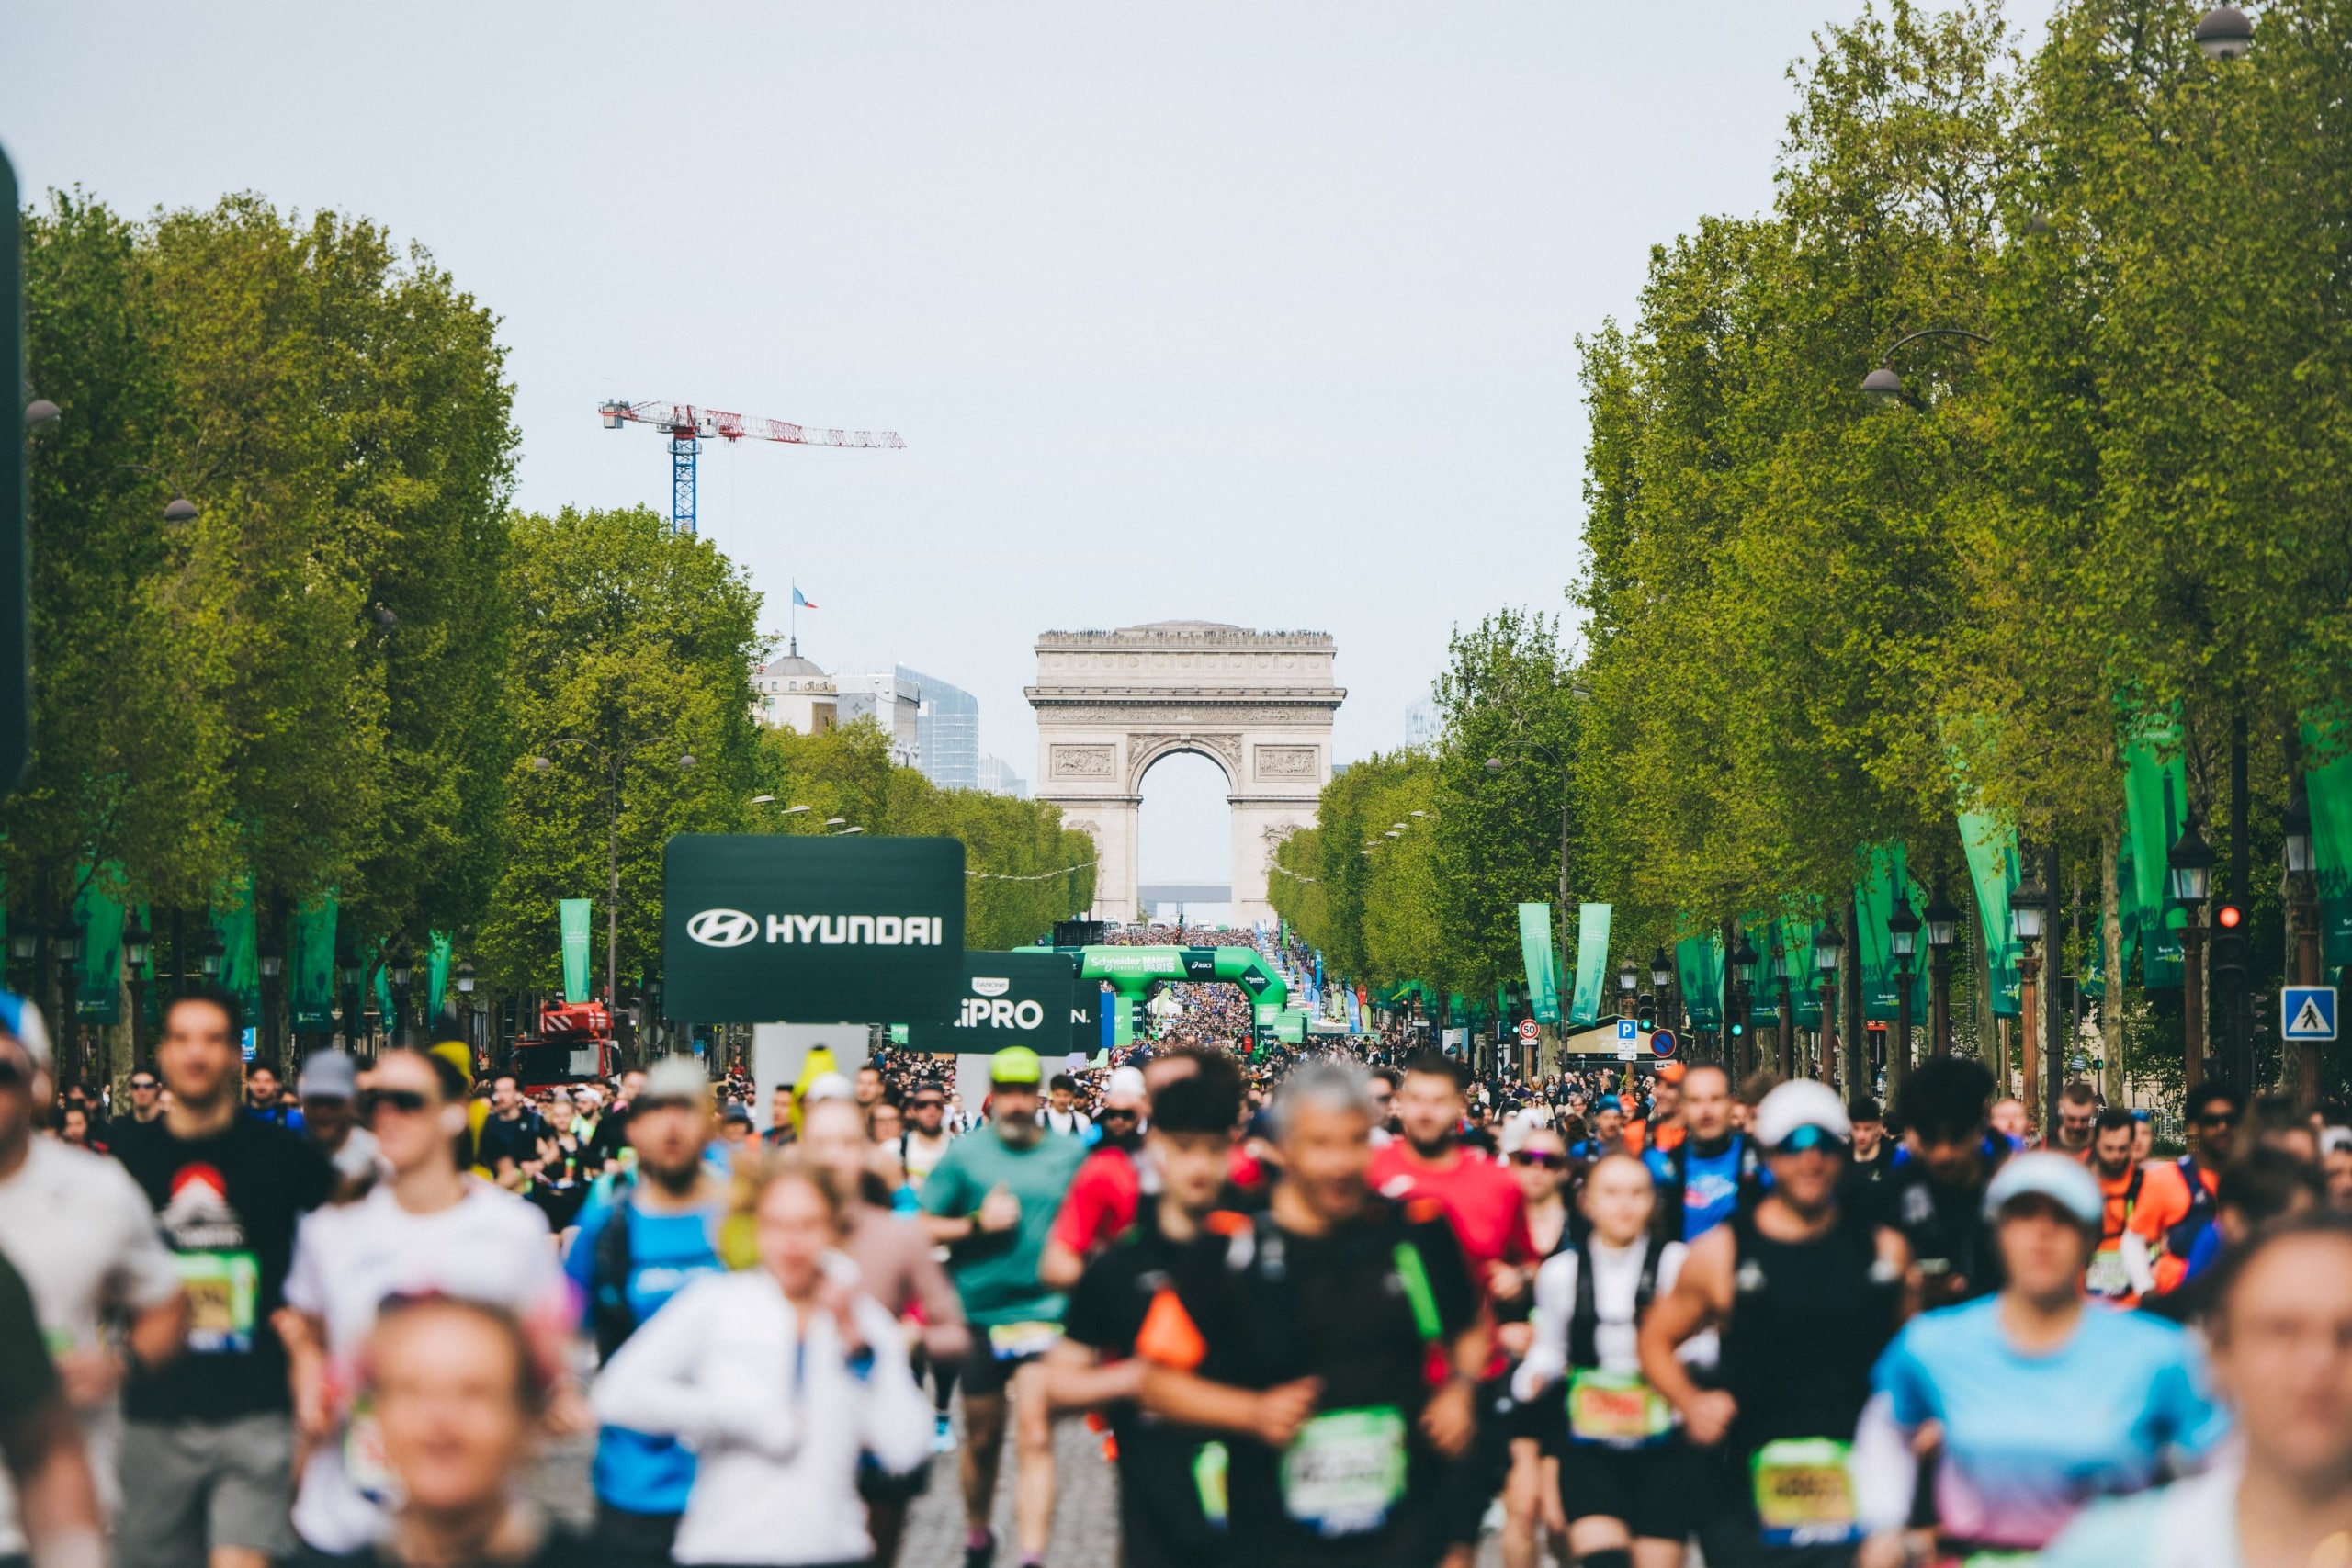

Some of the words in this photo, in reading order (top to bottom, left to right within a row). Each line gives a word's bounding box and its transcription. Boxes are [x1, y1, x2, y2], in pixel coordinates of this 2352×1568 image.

[766, 914, 942, 945] HYUNDAI
[1091, 957, 1142, 967] Schneider
[954, 998, 1044, 1030] iPRO
[1523, 1025, 1535, 1034] 50
[1623, 1023, 1632, 1037] P
